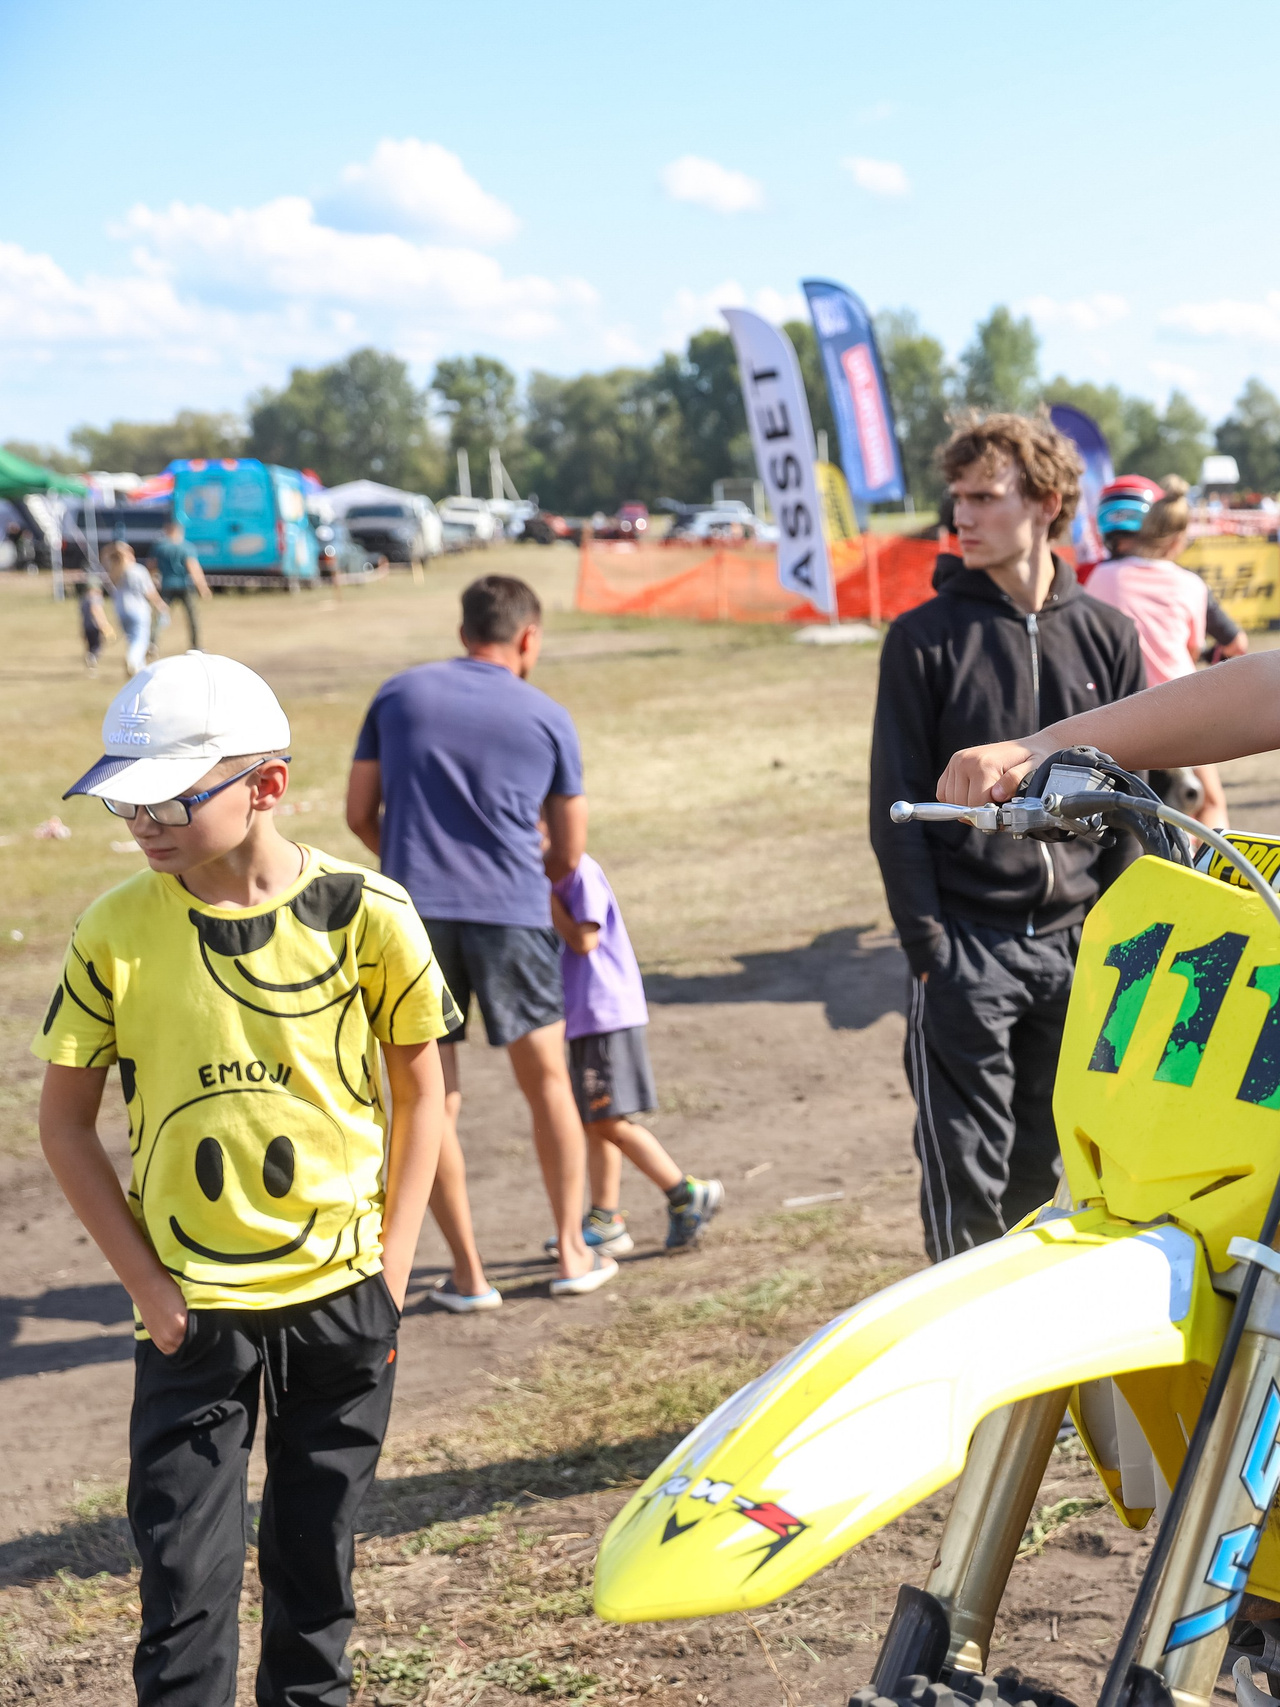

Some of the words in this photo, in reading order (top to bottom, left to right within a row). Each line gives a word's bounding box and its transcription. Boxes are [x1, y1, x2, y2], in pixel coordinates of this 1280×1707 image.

[749, 362, 818, 592] ASSET
[109, 728, 151, 745] adidas
[198, 1060, 292, 1089] EMOJI
